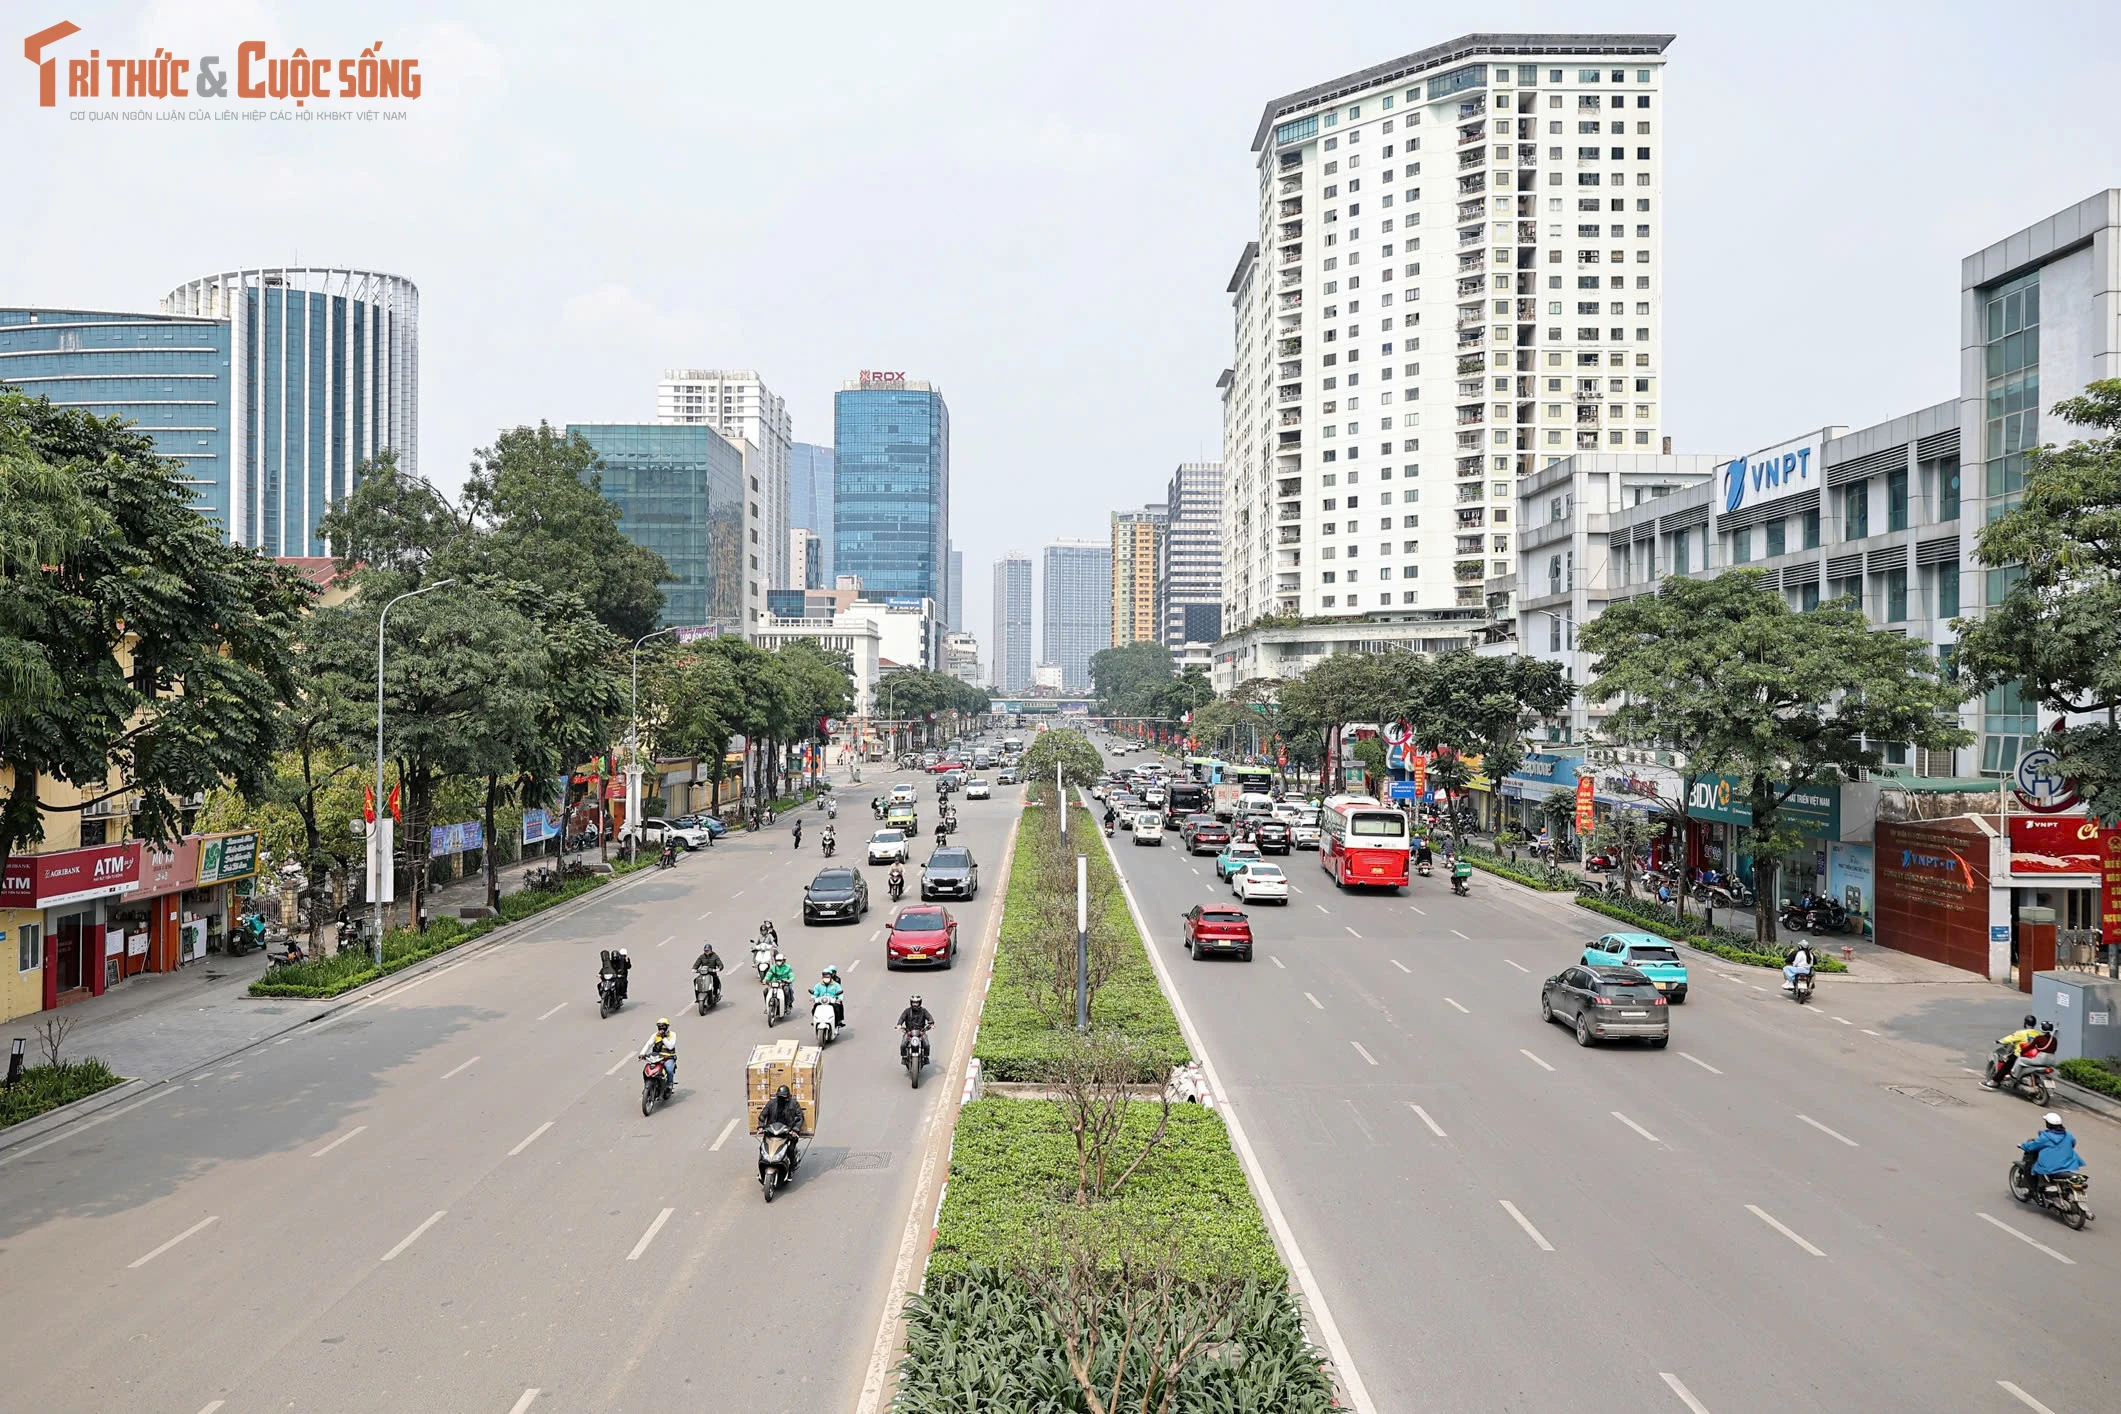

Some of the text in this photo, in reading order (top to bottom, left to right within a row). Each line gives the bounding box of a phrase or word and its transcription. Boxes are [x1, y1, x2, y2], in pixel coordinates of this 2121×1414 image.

[872, 371, 906, 382] ROX
[1751, 447, 1811, 493] VNPT
[1688, 782, 1719, 810] BIDV
[1819, 796, 1831, 808] NAM
[50, 866, 81, 878] AGRIBANK
[94, 856, 124, 876] ATM
